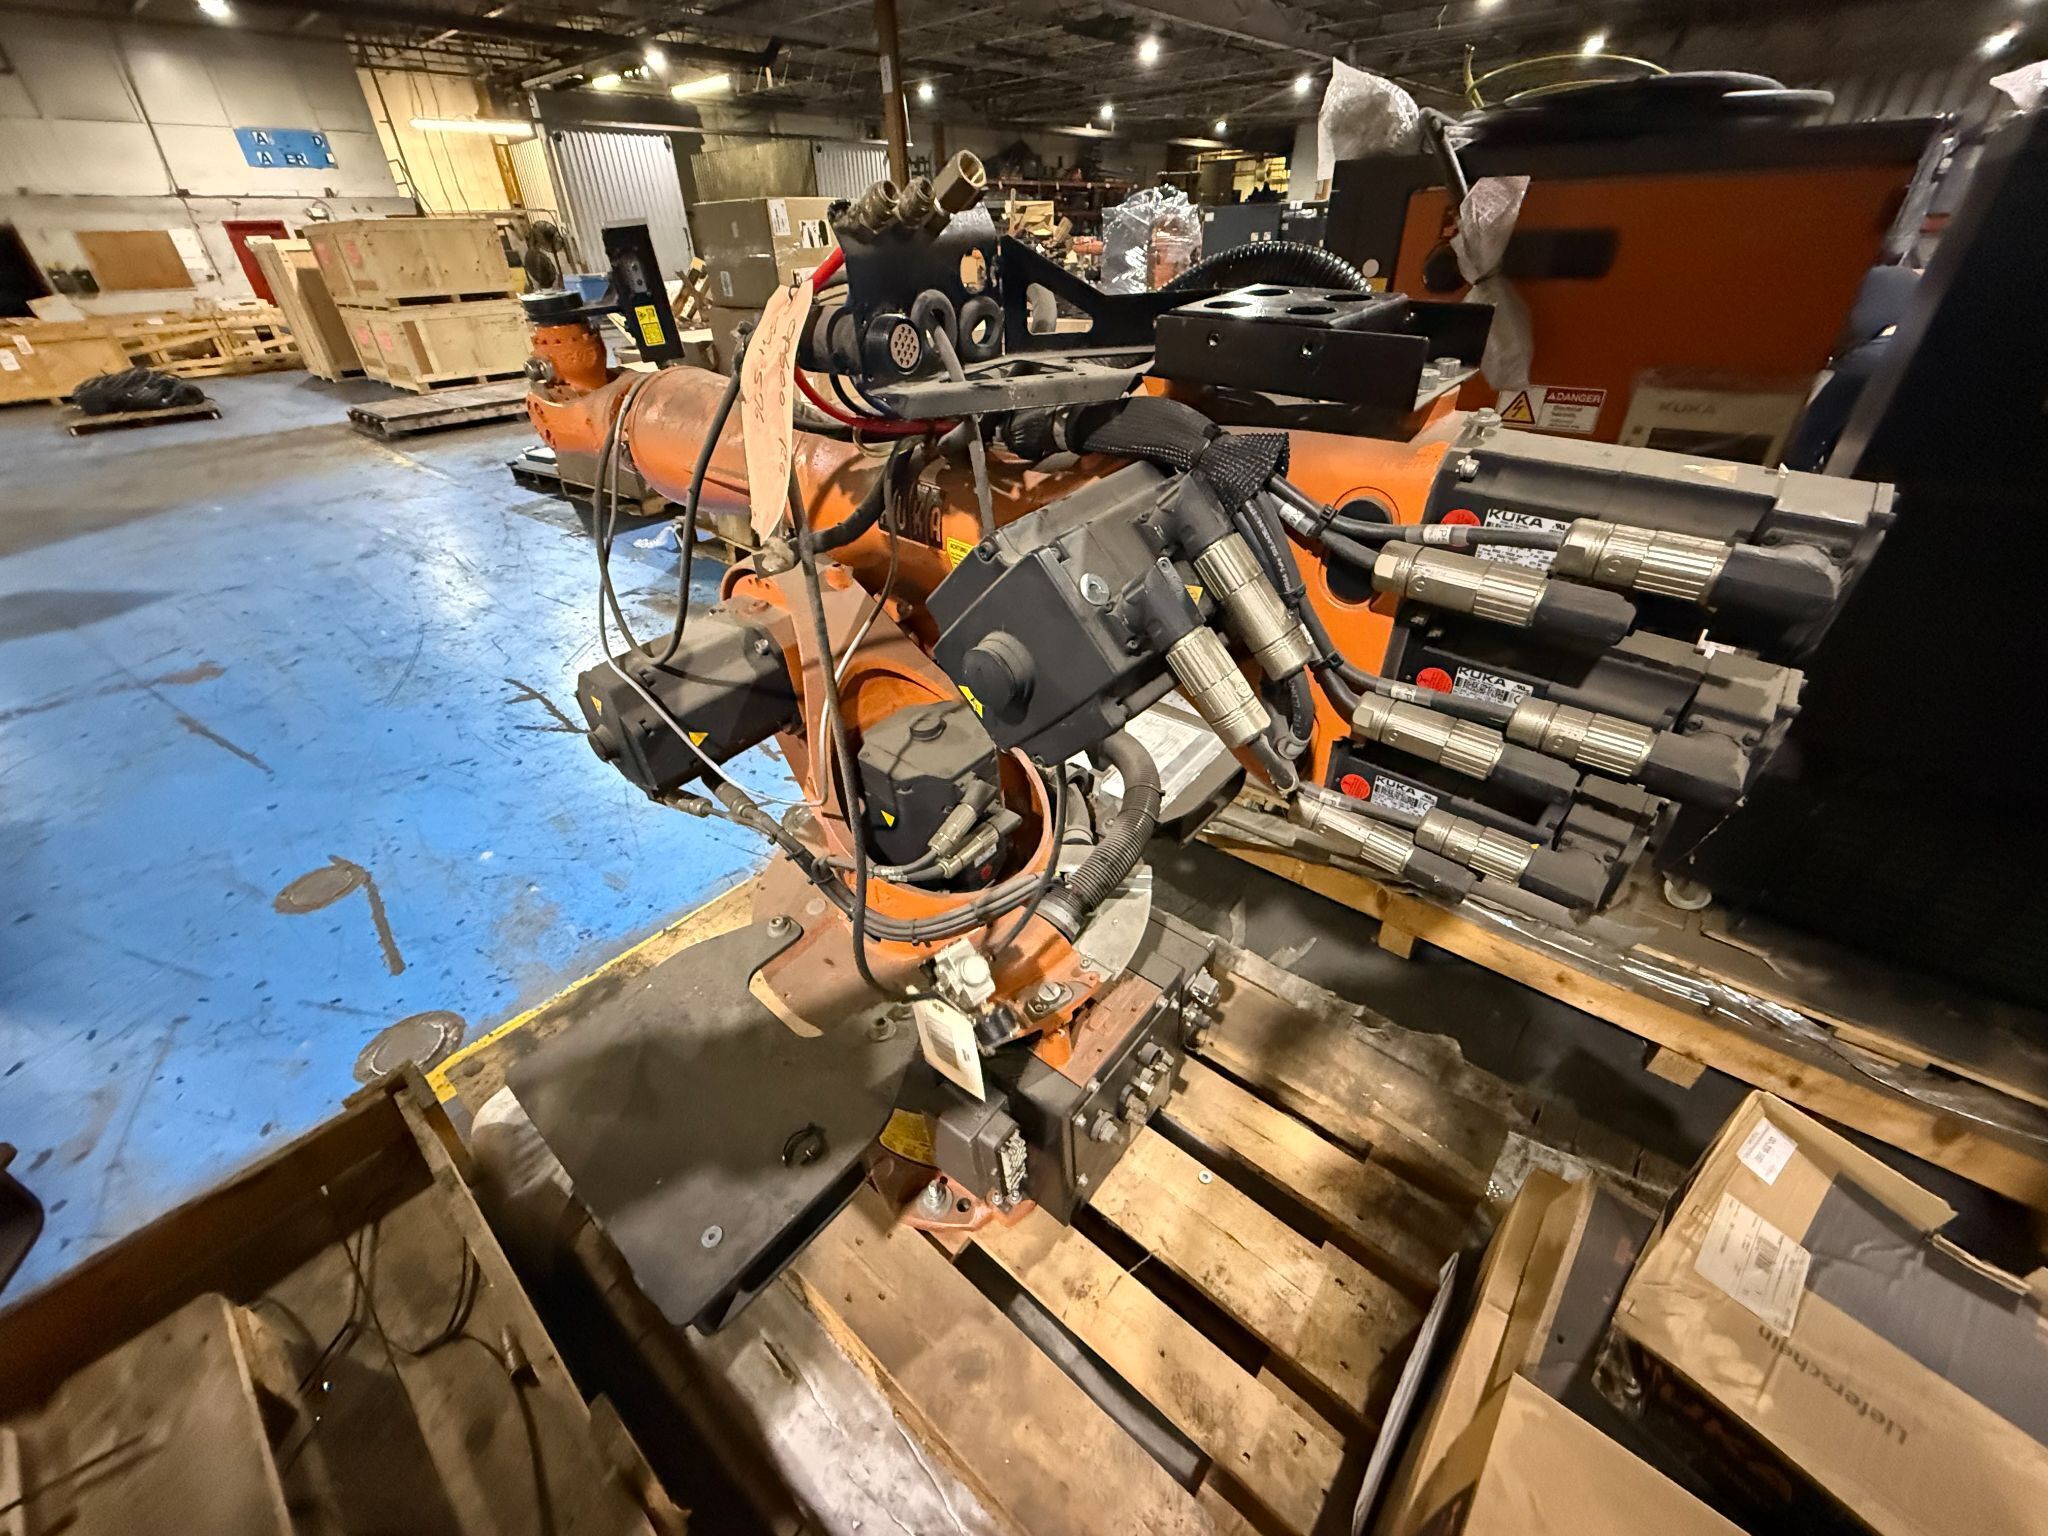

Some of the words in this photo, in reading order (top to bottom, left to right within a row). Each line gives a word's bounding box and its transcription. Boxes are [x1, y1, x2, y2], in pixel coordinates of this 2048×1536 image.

[1556, 391, 1601, 404] DANGER
[1657, 402, 1716, 415] KUKA
[1488, 508, 1543, 528] KUKA
[1458, 666, 1506, 688] KUKA
[1376, 775, 1416, 796] KUKA
[1758, 1324, 1908, 1446] Lieferschein
